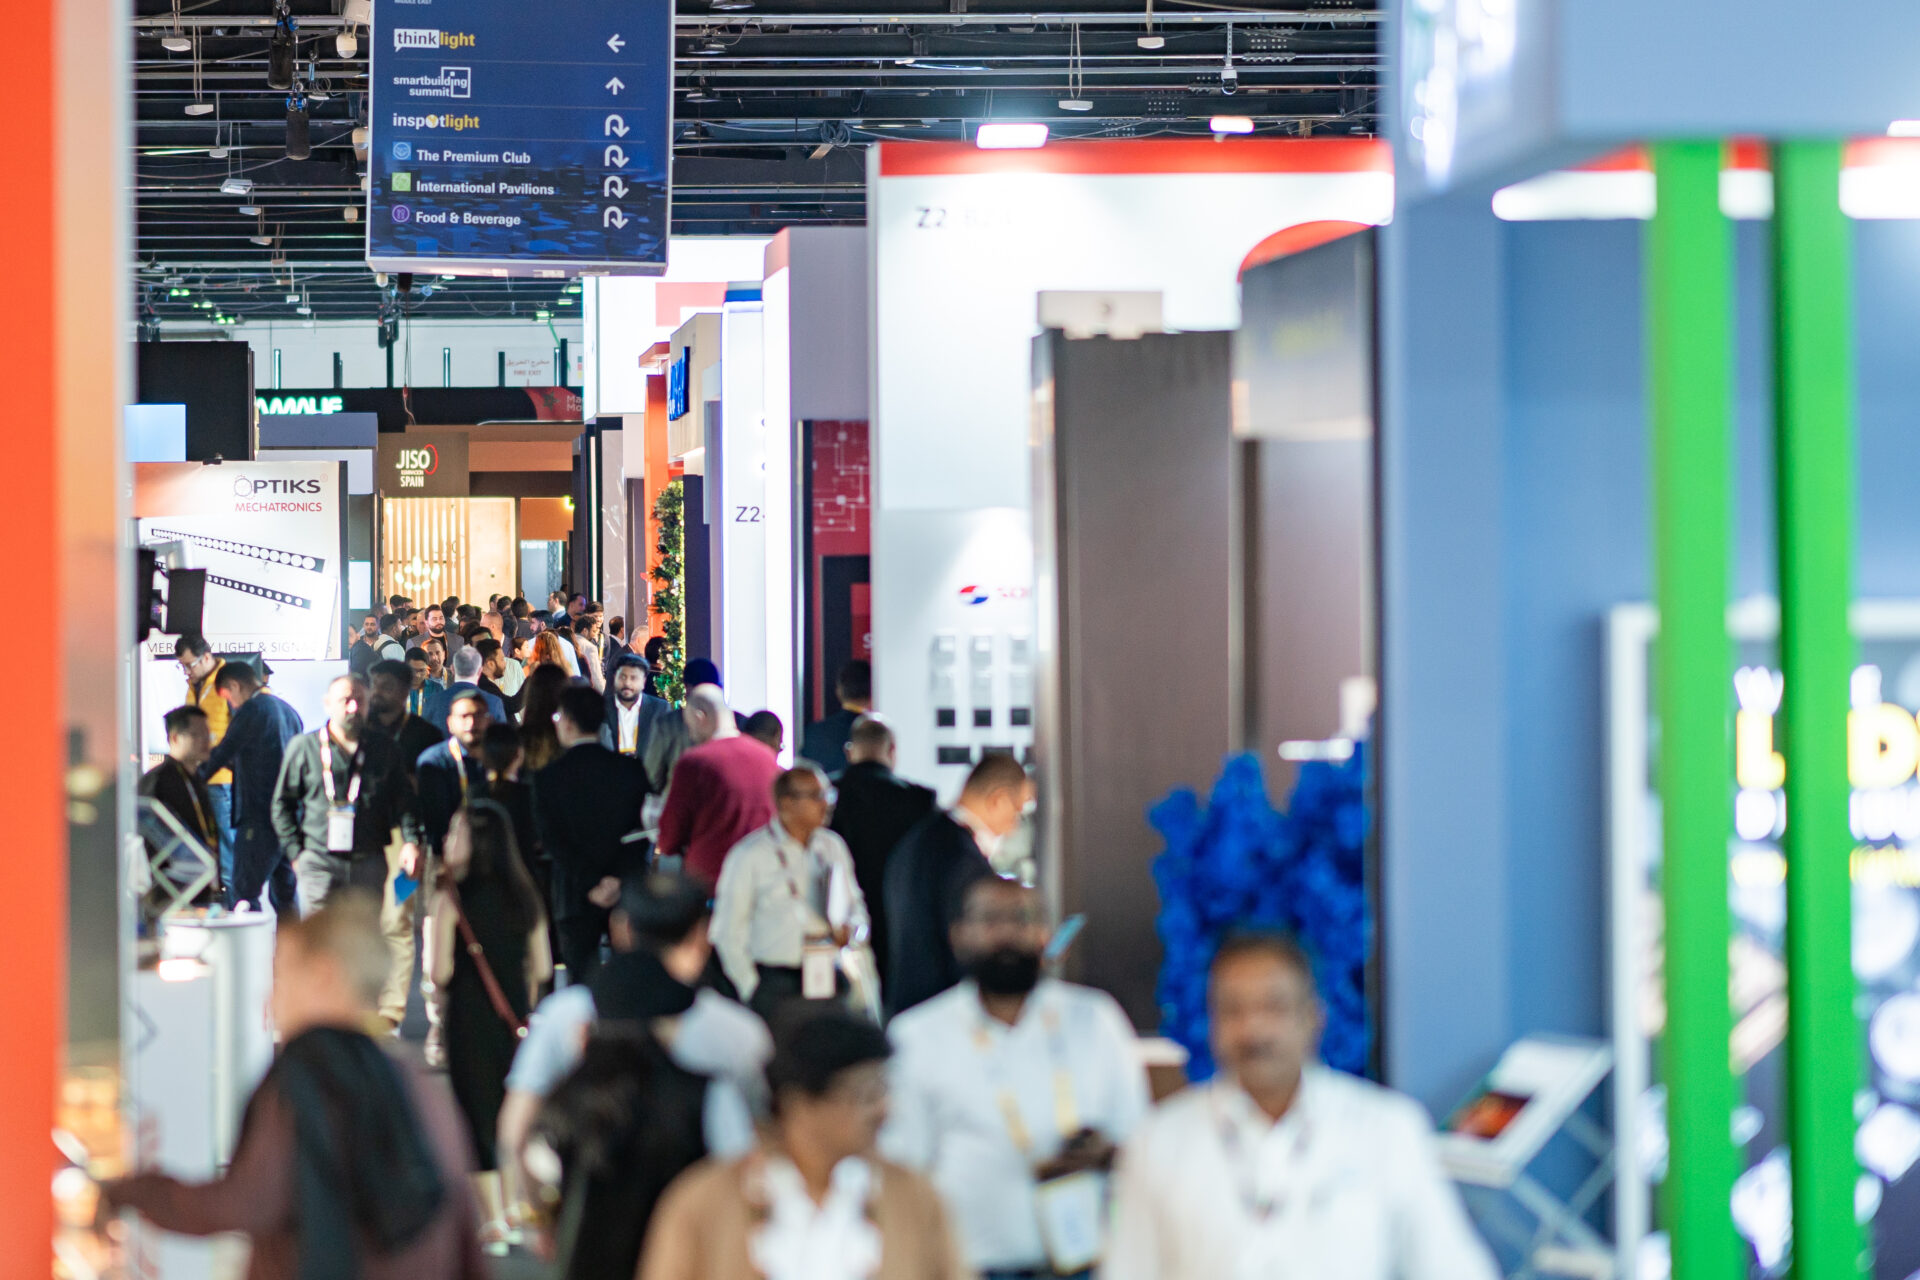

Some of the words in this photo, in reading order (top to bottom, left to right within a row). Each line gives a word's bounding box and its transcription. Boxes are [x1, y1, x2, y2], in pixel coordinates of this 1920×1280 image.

[397, 31, 475, 49] thinklight
[393, 71, 468, 88] smartbuilding
[409, 87, 450, 97] summit
[392, 112, 480, 131] inspotlight
[416, 149, 440, 162] The
[443, 150, 499, 163] Premium
[502, 151, 531, 164] Club
[416, 180, 495, 194] International
[499, 182, 554, 195] Pavilions
[416, 211, 446, 223] Food
[449, 212, 460, 224] &
[463, 212, 521, 227] Beverage
[395, 449, 431, 469] JISO
[400, 475, 424, 488] SPAIN
[235, 502, 322, 512] MECHATRONICS
[218, 643, 254, 652] LIGHT
[258, 643, 268, 653] &
